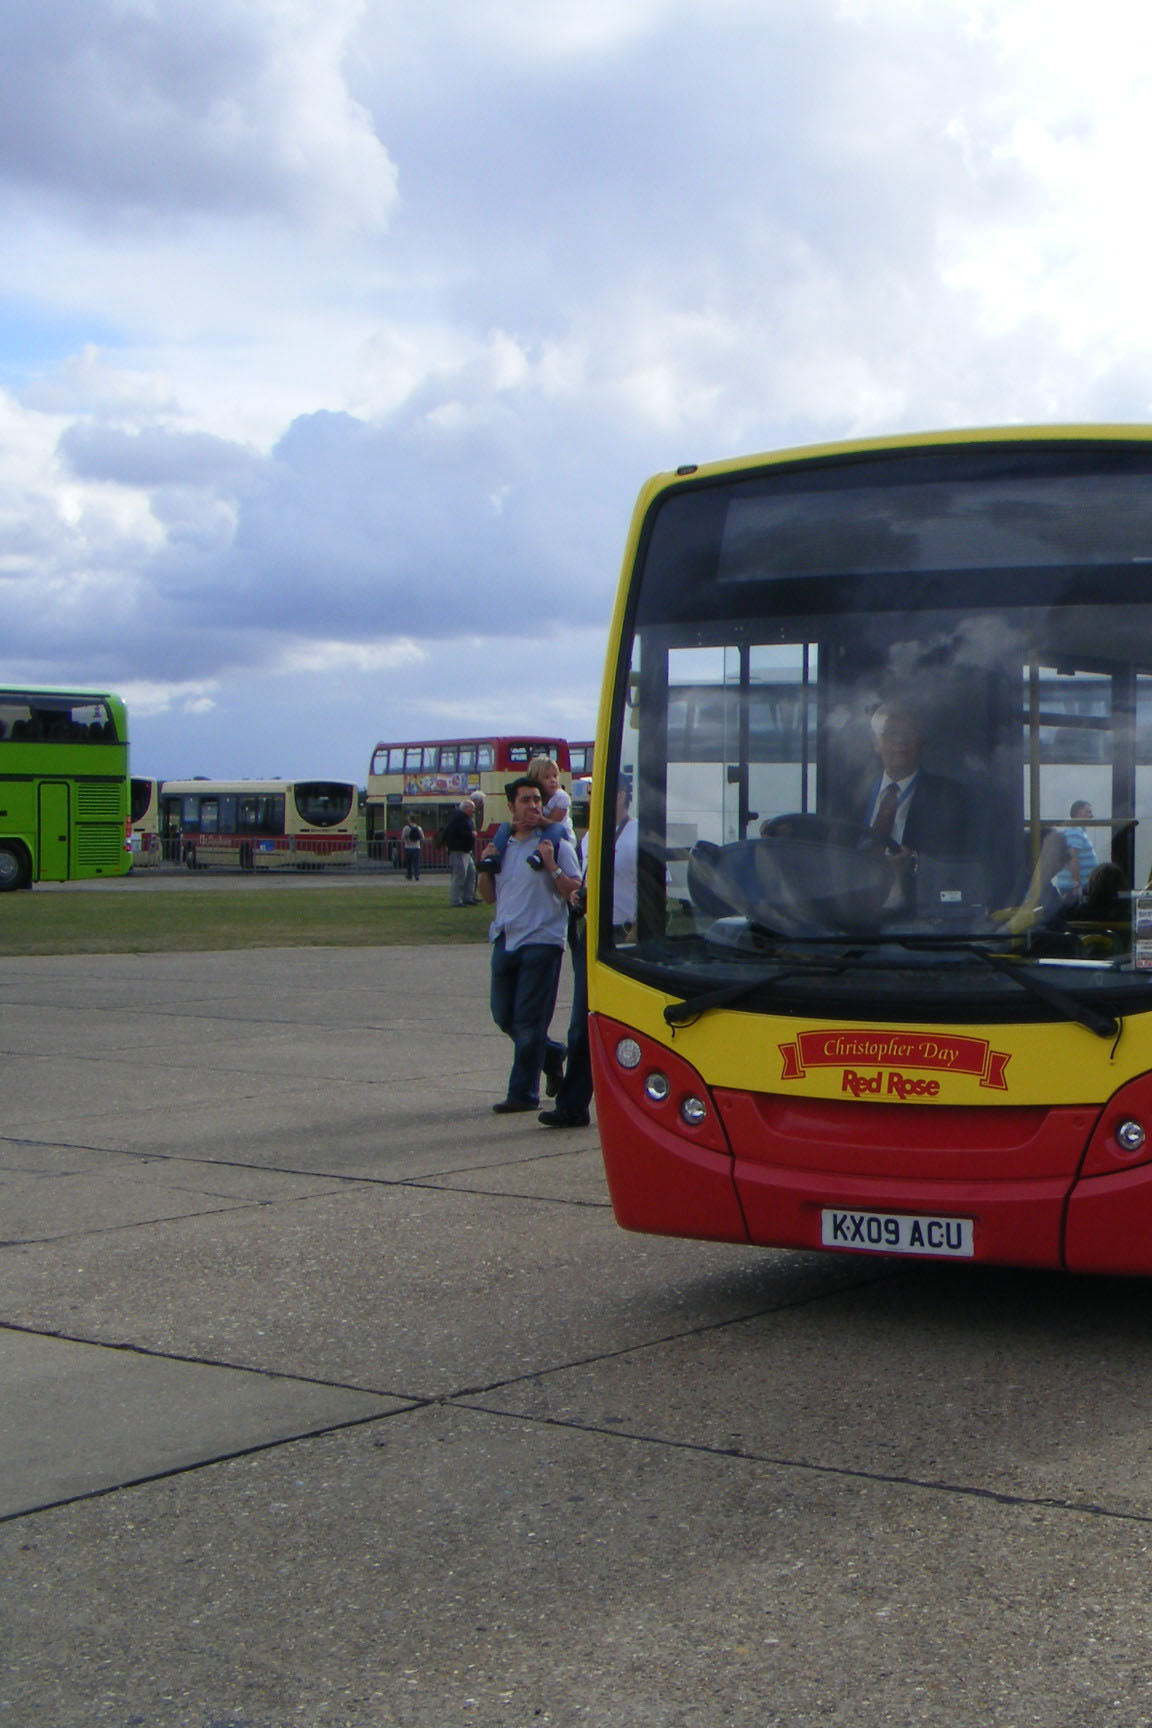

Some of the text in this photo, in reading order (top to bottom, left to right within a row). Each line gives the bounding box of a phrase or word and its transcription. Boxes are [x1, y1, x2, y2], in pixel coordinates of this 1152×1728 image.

[823, 1036, 959, 1067] Christopher Day
[842, 1069, 941, 1100] Red Rose
[832, 1213, 962, 1250] KX09 ACU
